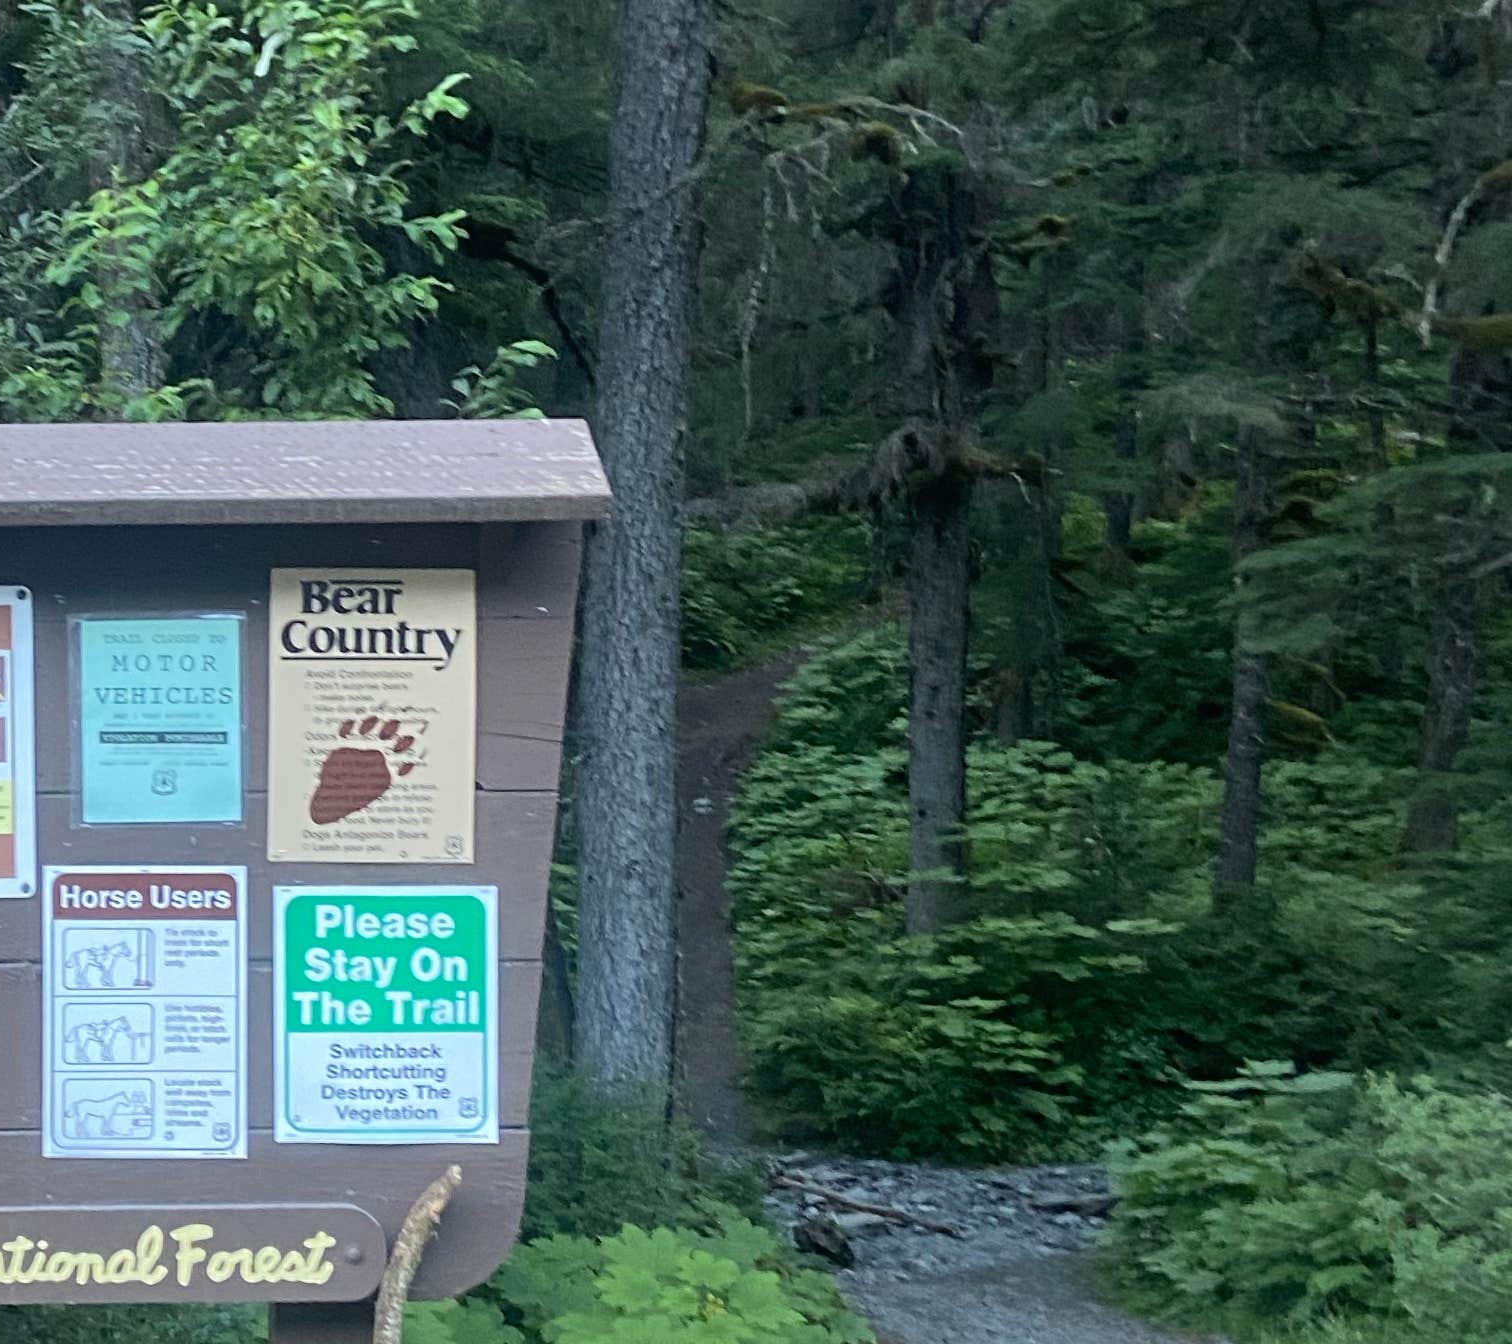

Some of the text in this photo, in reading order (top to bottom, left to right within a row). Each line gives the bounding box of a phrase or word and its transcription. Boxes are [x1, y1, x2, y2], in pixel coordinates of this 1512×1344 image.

[299, 579, 403, 615] Bear
[102, 633, 144, 644] TRAIL
[281, 620, 463, 671] Country
[111, 654, 219, 672] MOTOR
[94, 686, 233, 704] VEHICLES
[59, 884, 232, 909] Horse Users
[315, 903, 455, 939] Please
[304, 946, 468, 988] Stay On
[292, 990, 480, 1025] The Trail
[329, 1043, 442, 1060] Switchback
[326, 1064, 446, 1083] Shortcutting
[321, 1084, 451, 1104] Destroys The
[335, 1105, 439, 1124] Vegetation
[170, 1223, 336, 1286] Forest
